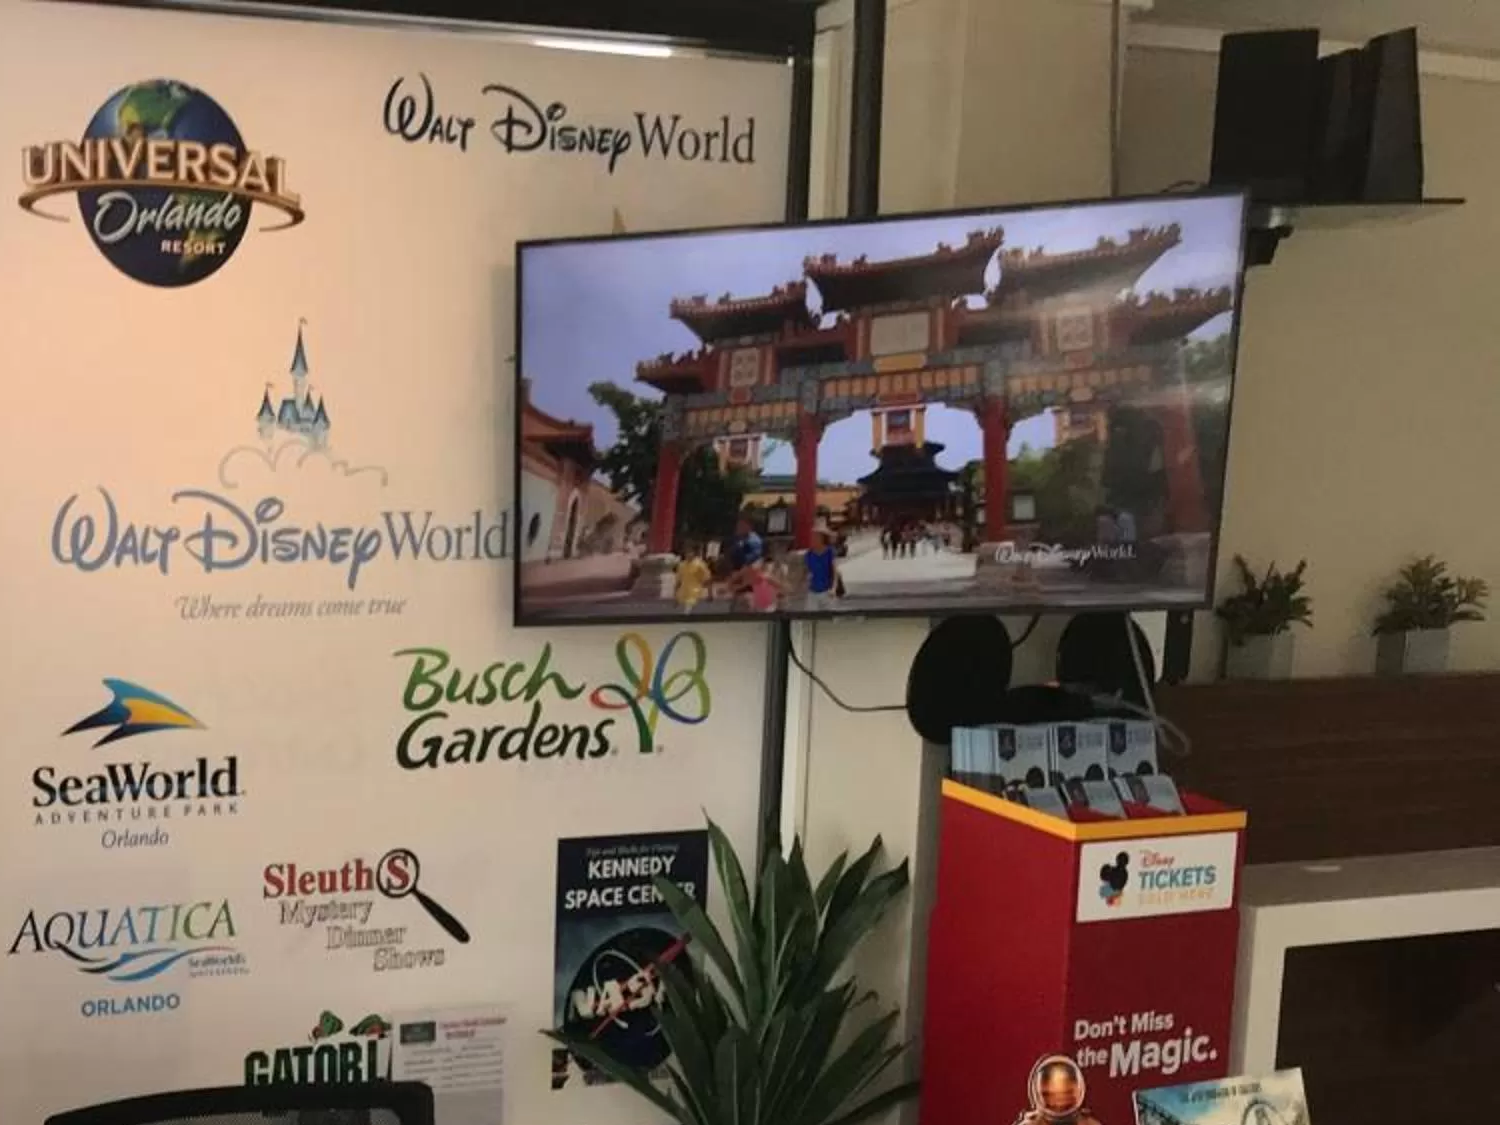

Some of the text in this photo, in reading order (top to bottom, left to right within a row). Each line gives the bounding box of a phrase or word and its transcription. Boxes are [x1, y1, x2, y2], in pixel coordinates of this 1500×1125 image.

[634, 112, 756, 164] World
[21, 138, 300, 202] UNIVERSAL
[93, 189, 242, 244] Orlando
[160, 238, 226, 257] RESORT
[380, 509, 508, 563] World
[173, 595, 408, 621] Where dreams come true
[393, 641, 587, 711] Busch
[396, 701, 616, 770] Gardens
[32, 756, 241, 809] SeaWorld
[34, 801, 239, 826] ADVENTURE PARK
[100, 828, 170, 851] Orlando
[588, 854, 675, 880] KENNEDY
[1138, 866, 1217, 890] TICKETS
[278, 899, 374, 926] Mystery
[564, 887, 622, 911] SPACE
[8, 899, 237, 956] AQUATICA
[326, 925, 407, 949] Dinner
[372, 946, 446, 972] Shows
[81, 993, 181, 1018] ORLANDO
[1074, 1010, 1174, 1041] Don't Miss
[1076, 1028, 1218, 1078] the Magic.
